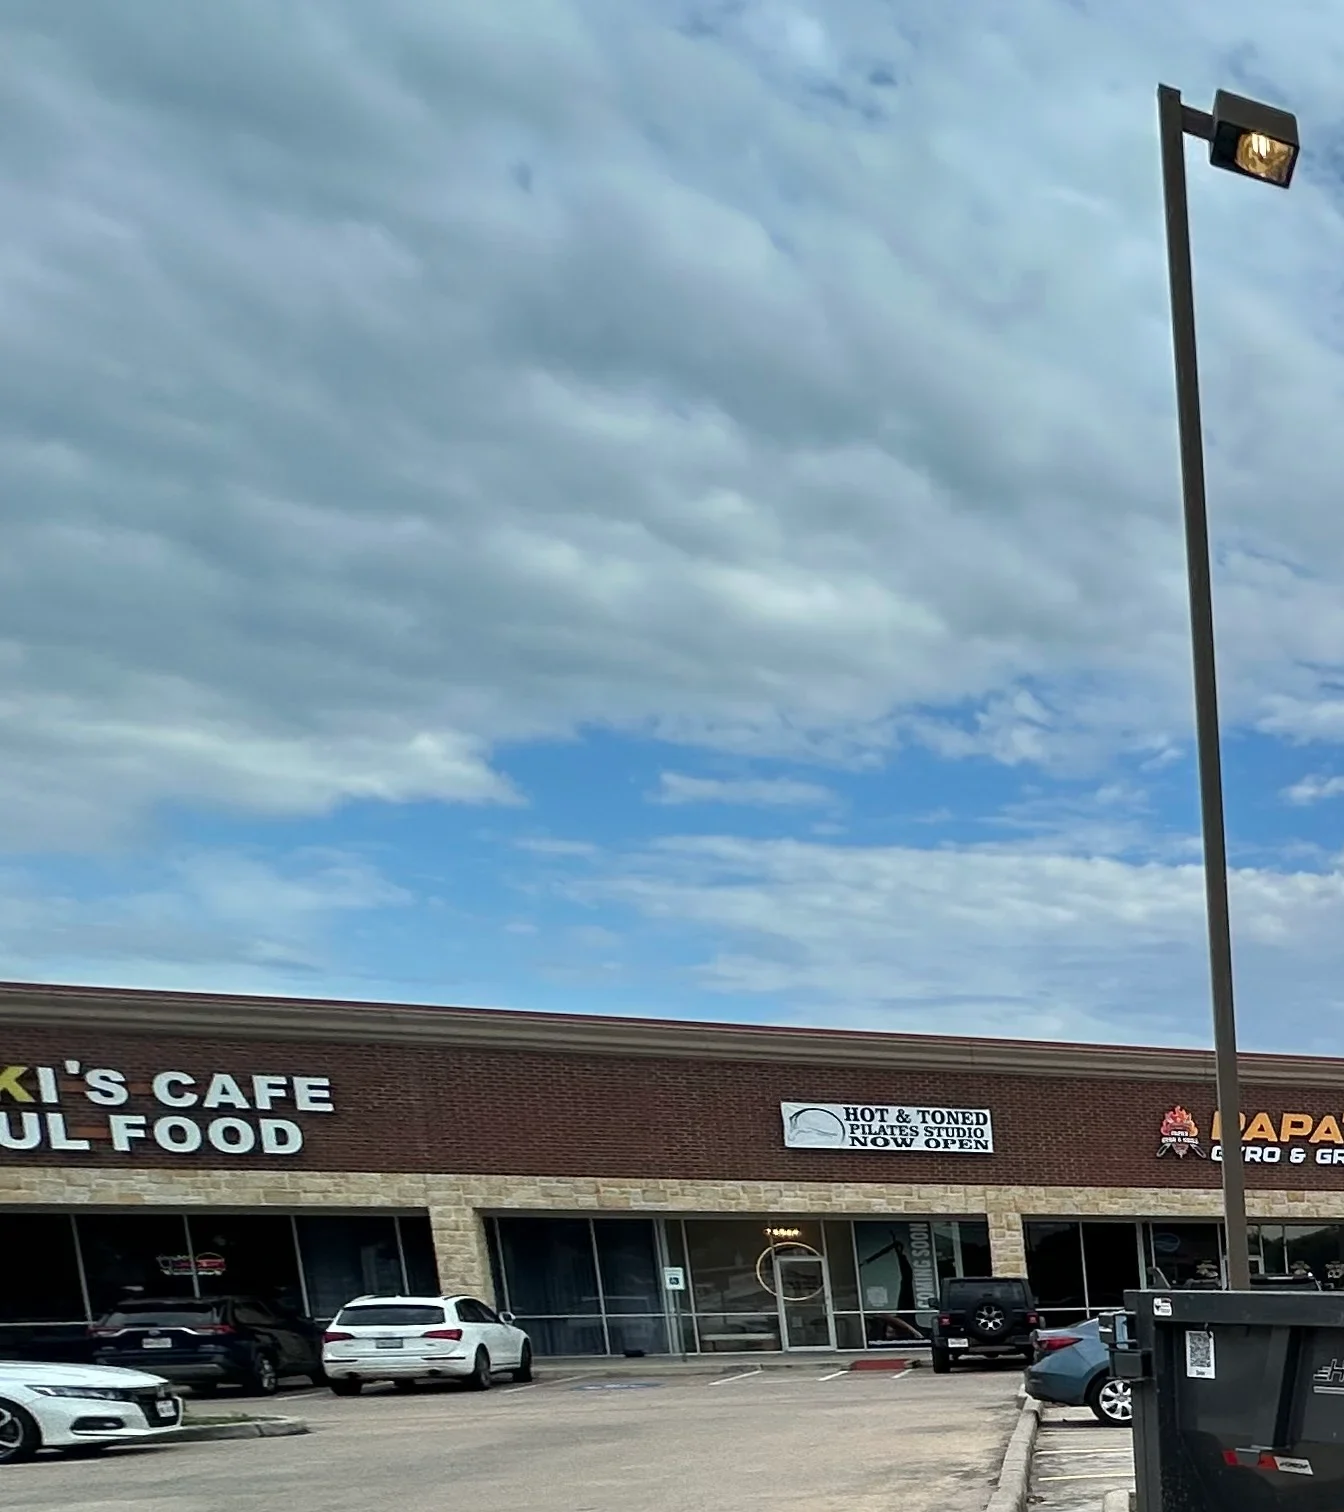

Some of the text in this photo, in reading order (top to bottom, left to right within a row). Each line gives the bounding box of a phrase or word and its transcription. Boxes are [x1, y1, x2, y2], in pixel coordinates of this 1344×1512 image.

[152, 1071, 334, 1112] CAFE
[843, 1107, 988, 1126] HOT & TONED
[109, 1114, 303, 1154] FOOD
[850, 1123, 985, 1138] PILATES STUDIO
[850, 1136, 989, 1150] NOW OPEN
[1210, 1146, 1281, 1163] GRO
[1290, 1148, 1306, 1163] &
[909, 1223, 935, 1309] COMING SOON
